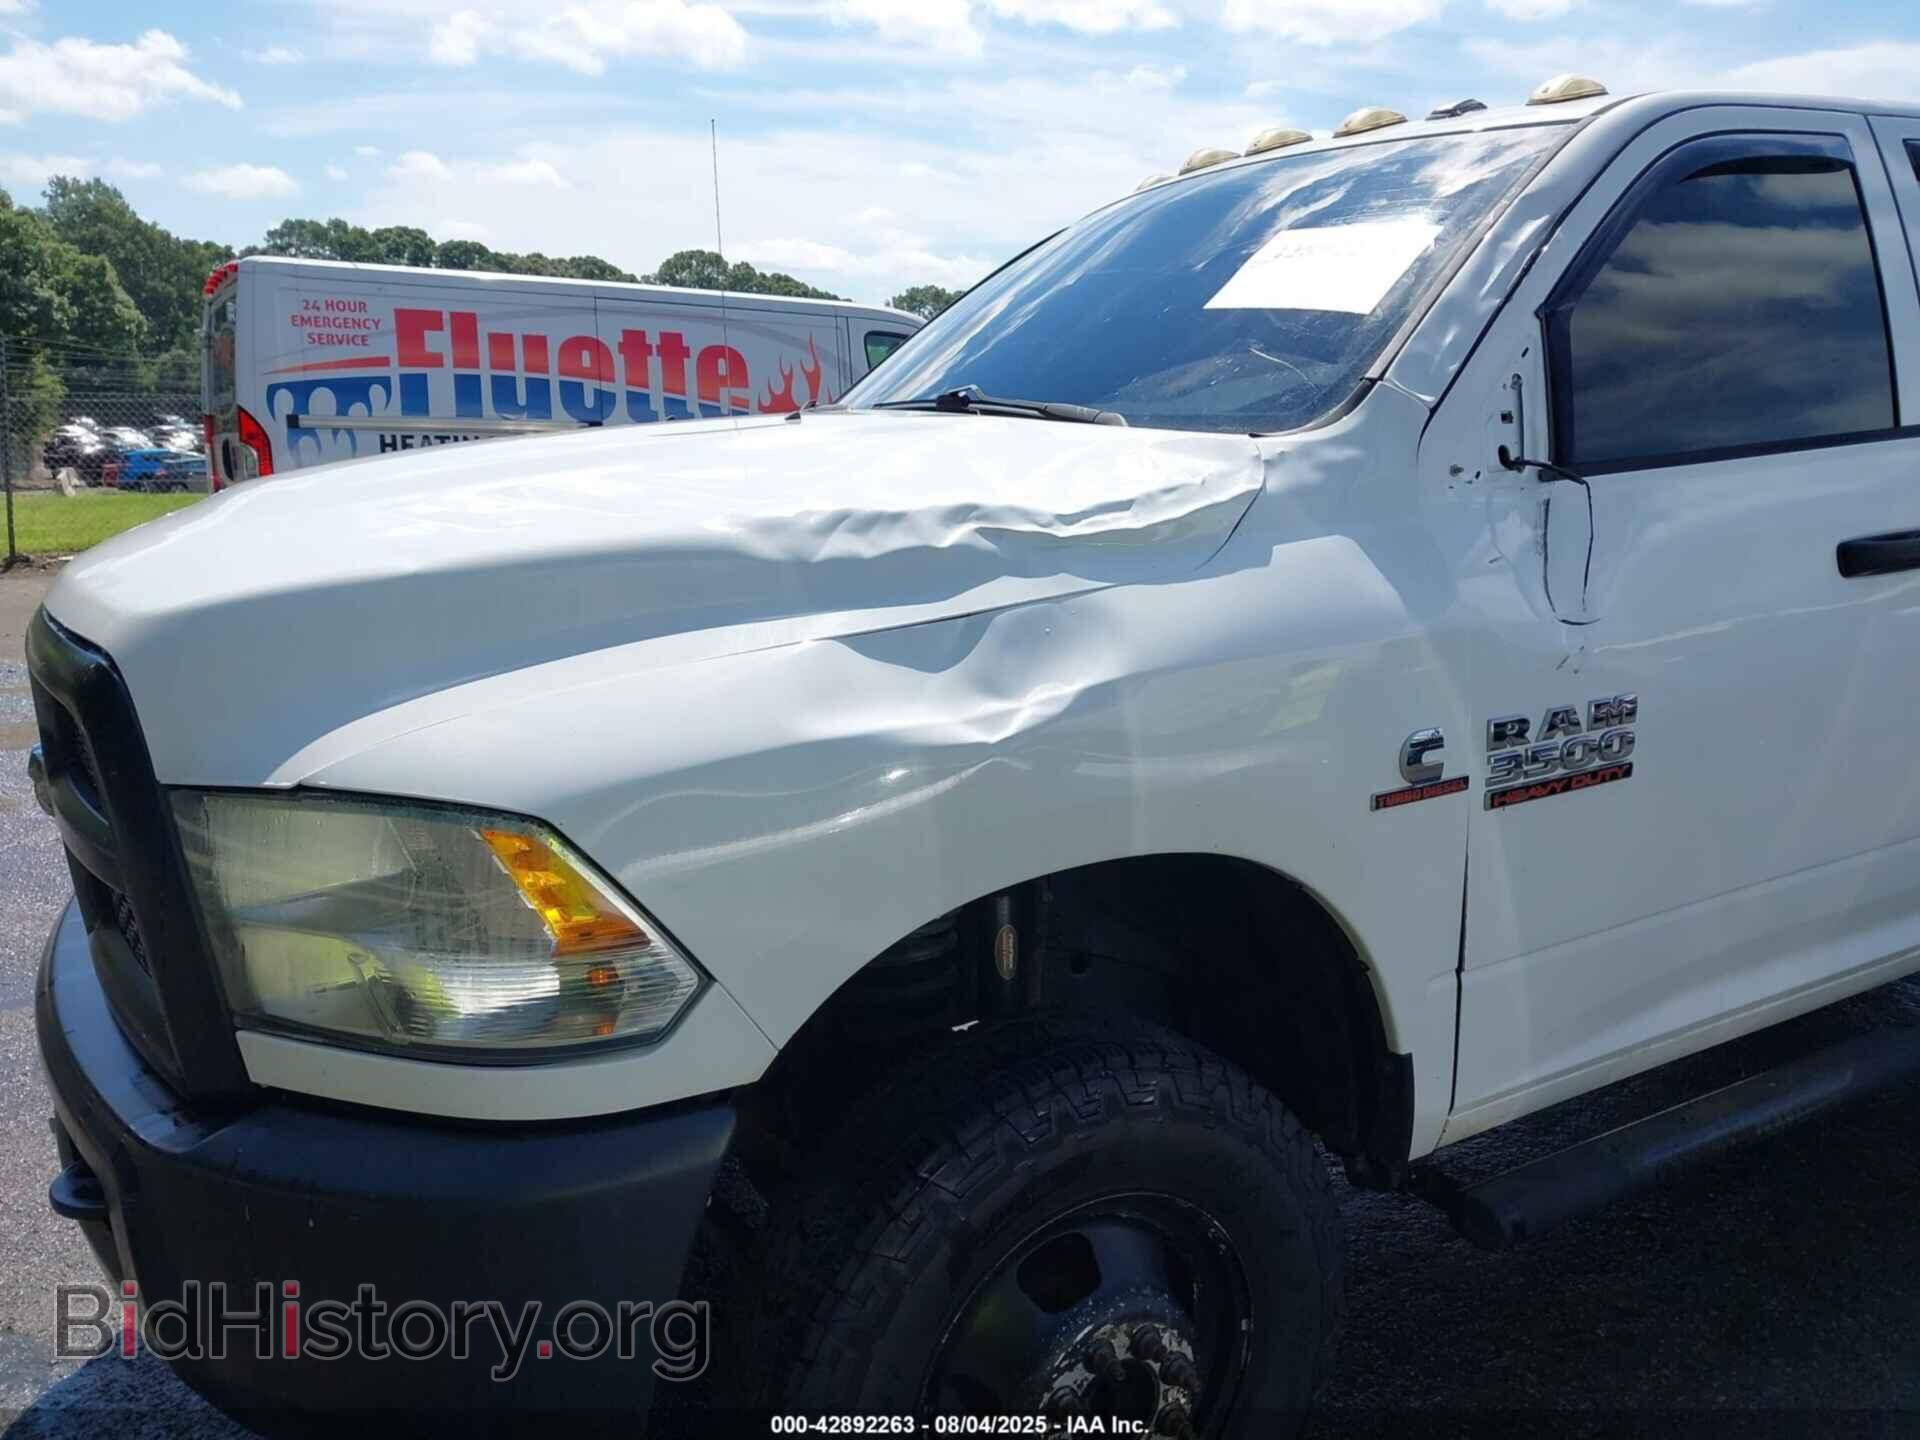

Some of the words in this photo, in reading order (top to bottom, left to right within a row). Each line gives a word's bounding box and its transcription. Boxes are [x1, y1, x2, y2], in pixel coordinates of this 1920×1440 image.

[291, 315, 381, 330] EMERGENCY
[302, 299, 320, 311] 24
[324, 299, 367, 313] HOUR
[307, 333, 369, 346] SERVICE
[393, 308, 750, 423] Fluette
[1486, 693, 1638, 752] RAM
[1485, 728, 1636, 788] 3500
[1493, 780, 1566, 807] HEAVY
[1570, 764, 1630, 790] DUTY
